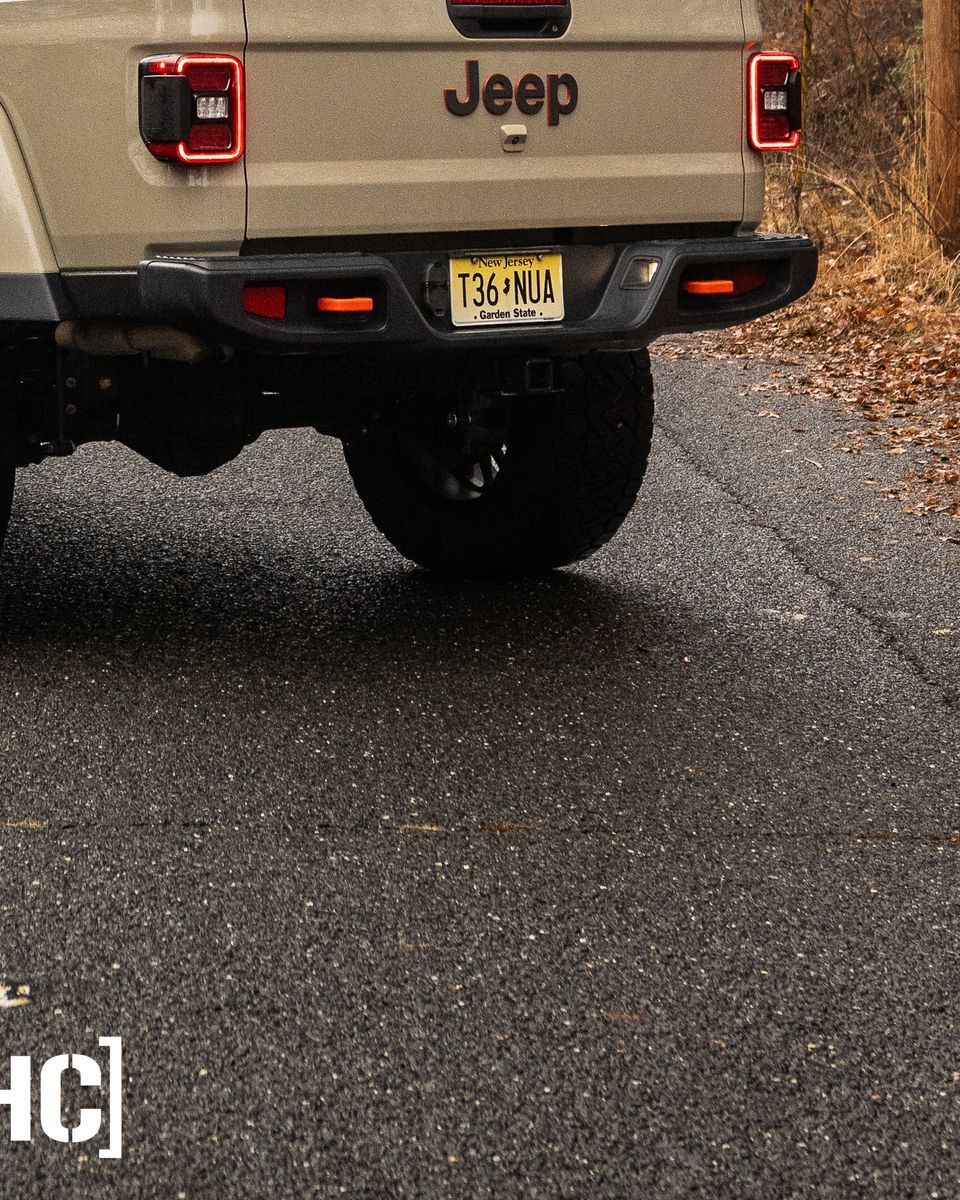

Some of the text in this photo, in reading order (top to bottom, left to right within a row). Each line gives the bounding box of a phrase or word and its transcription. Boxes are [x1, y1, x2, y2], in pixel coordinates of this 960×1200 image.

[443, 58, 579, 127] Jeep
[478, 256, 535, 270] New Jersey
[479, 308, 537, 320] Garden State
